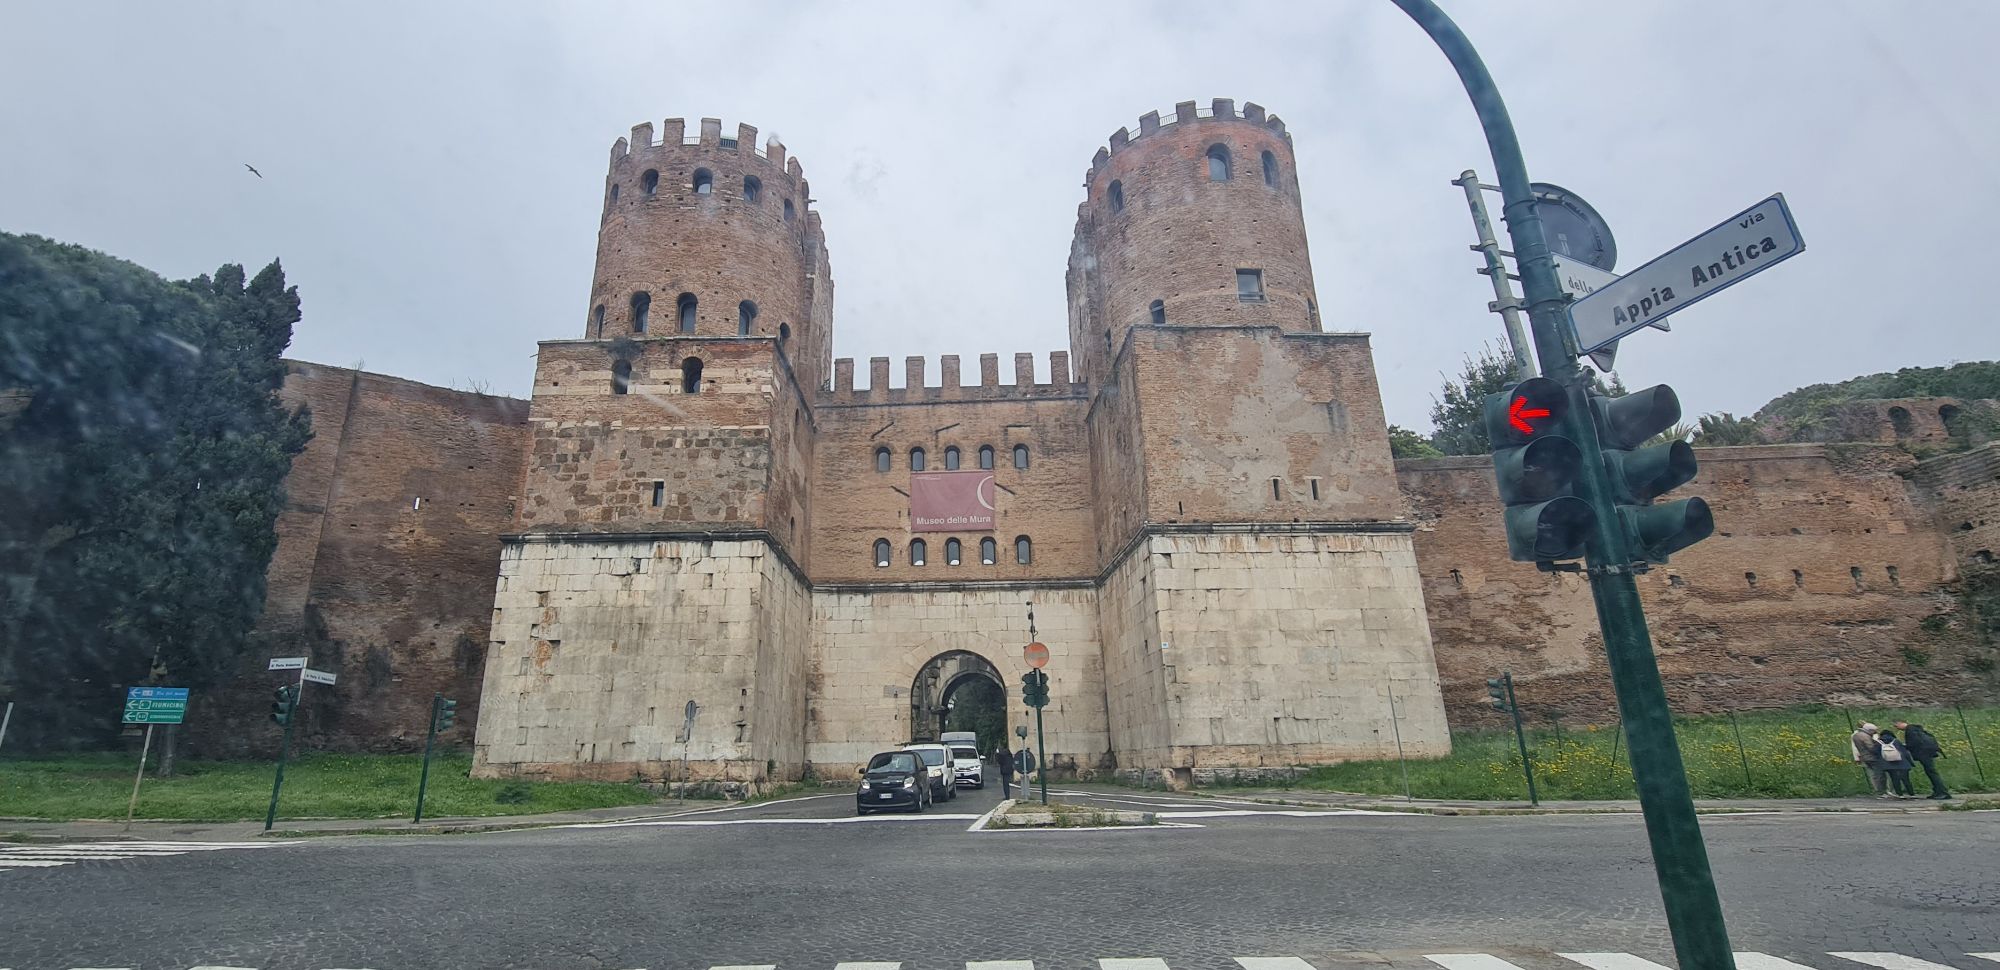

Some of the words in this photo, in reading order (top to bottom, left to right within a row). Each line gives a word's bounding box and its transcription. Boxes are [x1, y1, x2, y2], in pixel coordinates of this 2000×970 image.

[1739, 211, 1765, 229] via
[1612, 286, 1676, 326] Appia
[1691, 236, 1777, 288] Antica
[916, 516, 945, 525] Museo
[946, 515, 968, 524] delle
[969, 515, 991, 523] Mura
